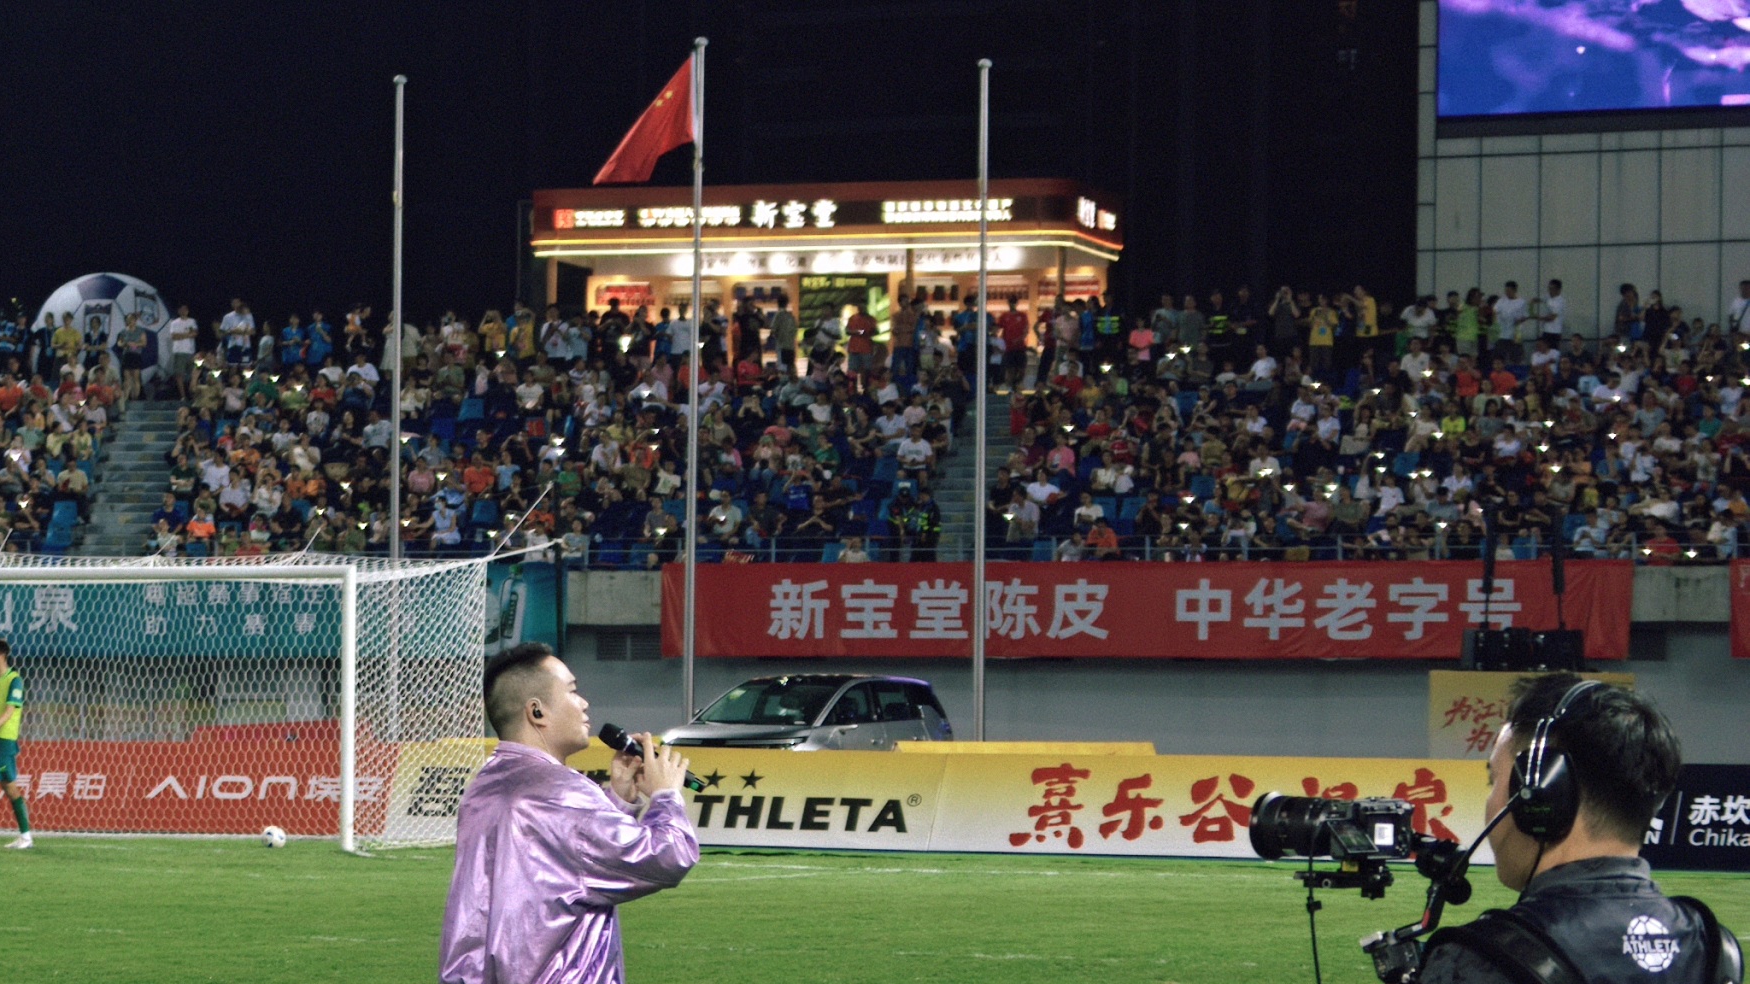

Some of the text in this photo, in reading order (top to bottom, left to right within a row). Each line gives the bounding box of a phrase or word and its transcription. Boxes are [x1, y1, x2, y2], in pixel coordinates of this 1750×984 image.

[751, 199, 838, 229] 新宝堂
[767, 577, 1522, 641] 新宝堂陈皮 中华老字号
[146, 776, 299, 801] AION
[692, 795, 908, 833] THLETA
[1009, 762, 1460, 856] 熹乐谷泉
[1688, 795, 1750, 825] 赤坎
[1623, 938, 1681, 954] ATHLETA
